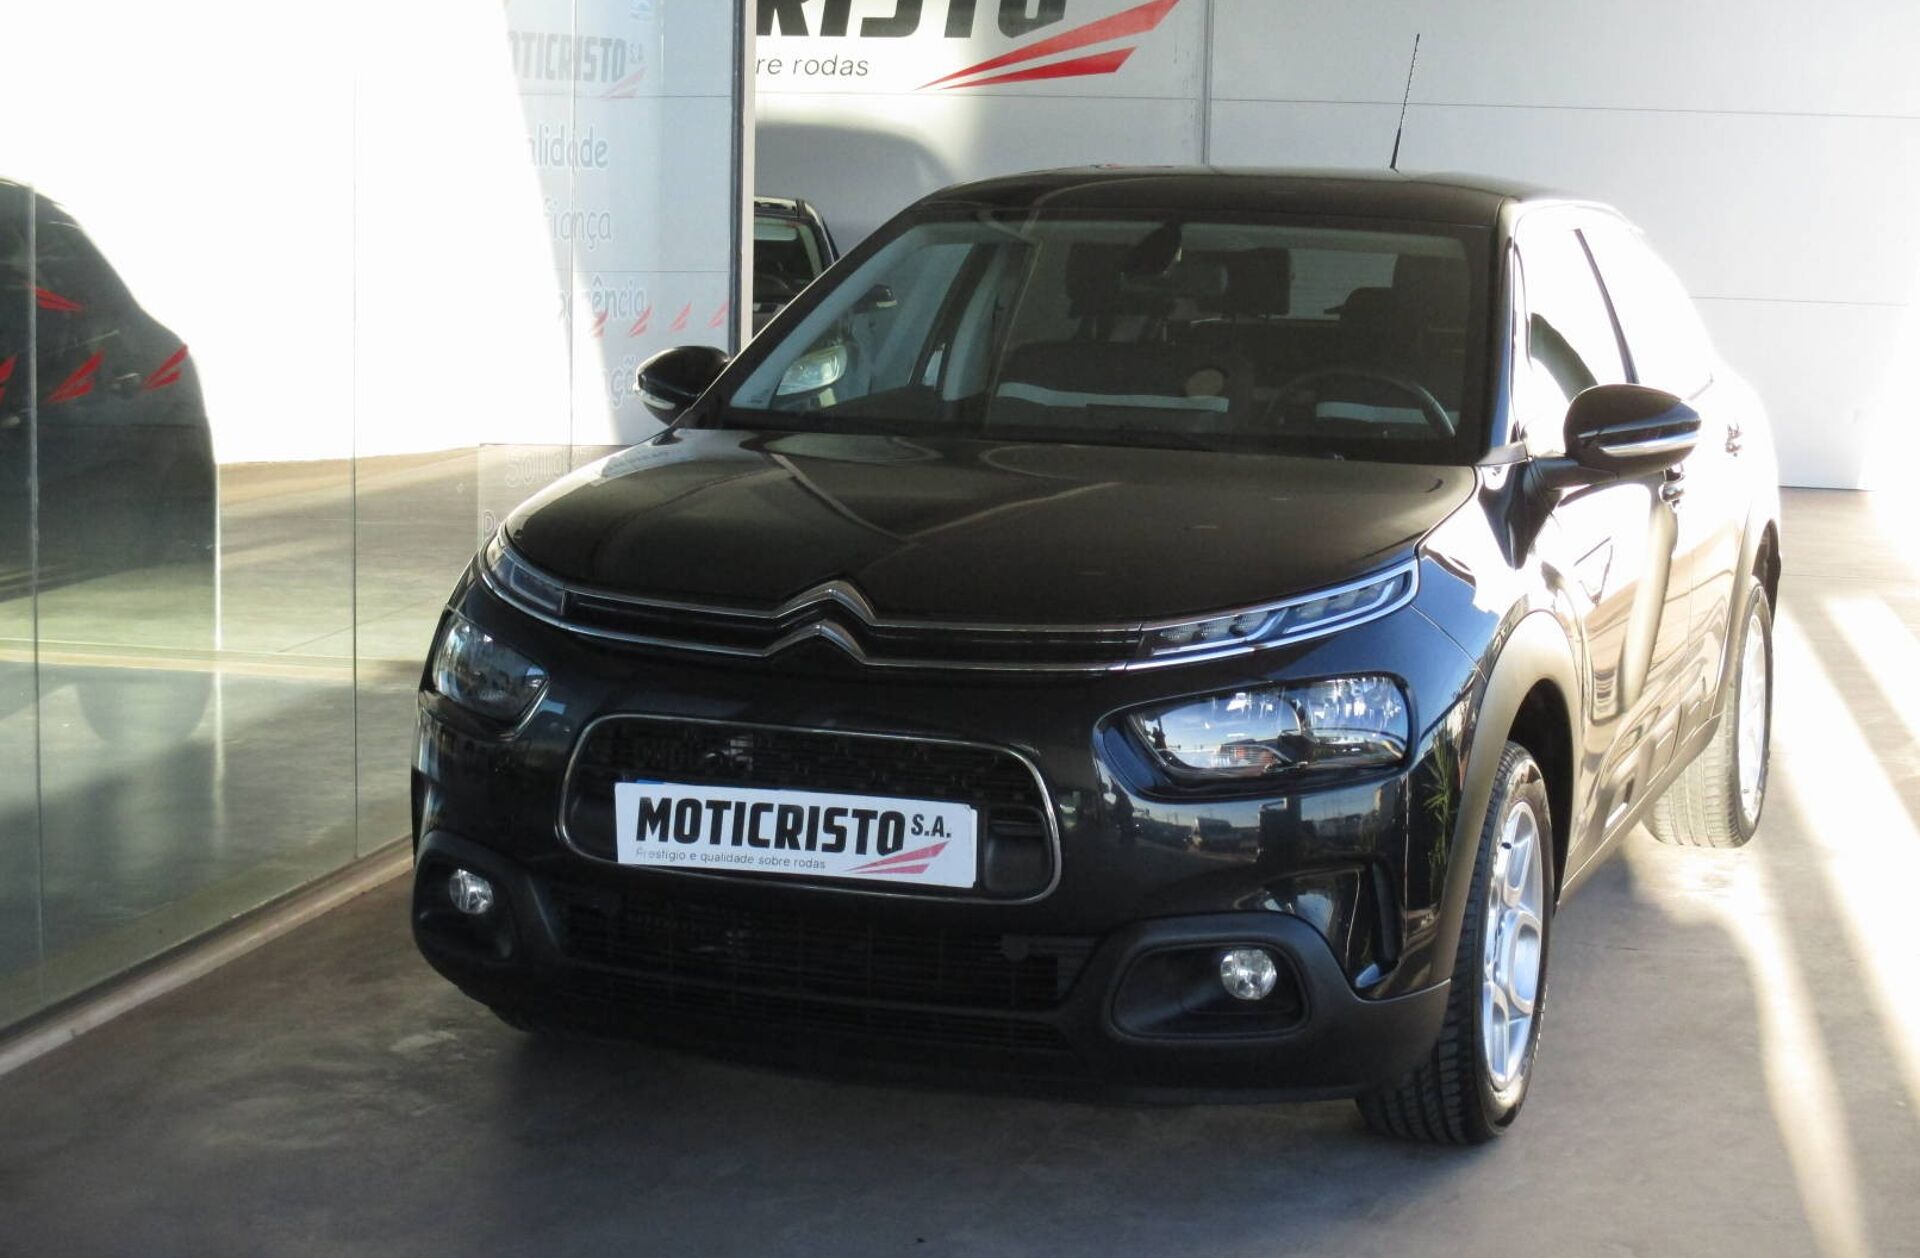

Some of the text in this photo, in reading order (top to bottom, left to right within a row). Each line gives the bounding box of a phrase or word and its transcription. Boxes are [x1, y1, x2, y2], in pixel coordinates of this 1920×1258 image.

[793, 54, 869, 76] rodas
[636, 797, 952, 856] MOTICRISTO S.A.
[690, 852, 697, 860] e
[701, 851, 754, 864] qualidade
[758, 854, 790, 867] sobre
[794, 857, 826, 869] rodas
